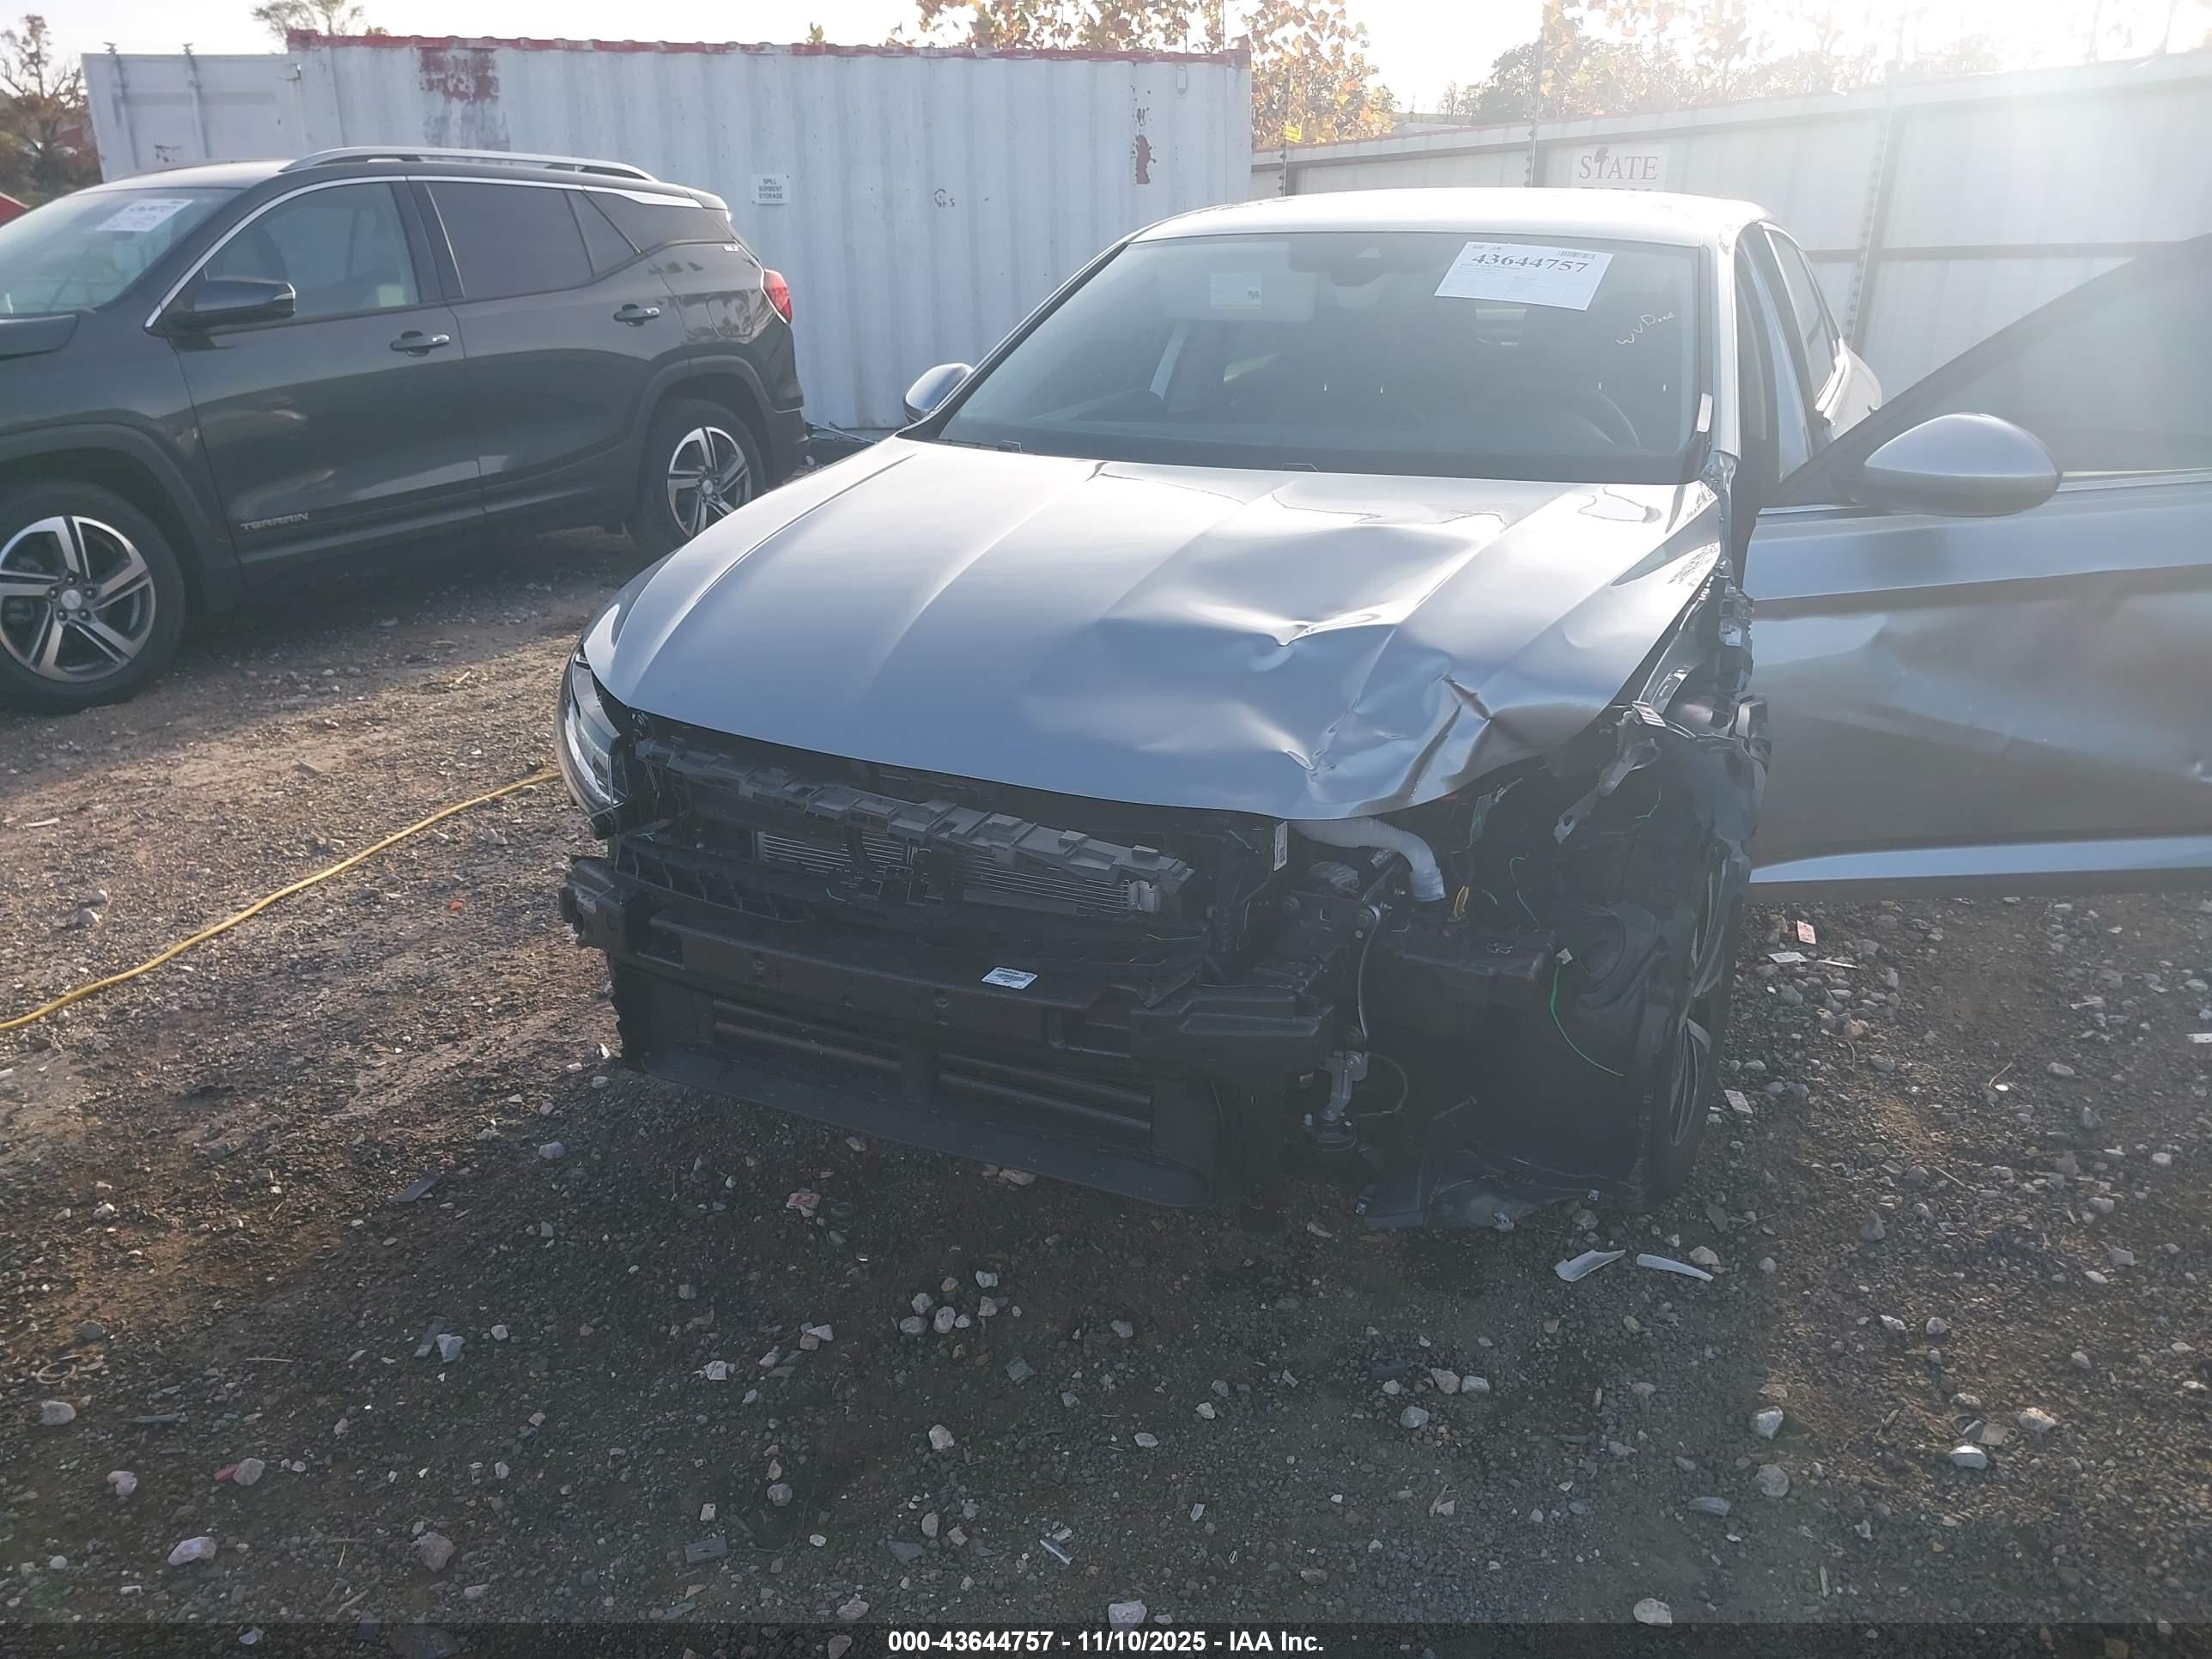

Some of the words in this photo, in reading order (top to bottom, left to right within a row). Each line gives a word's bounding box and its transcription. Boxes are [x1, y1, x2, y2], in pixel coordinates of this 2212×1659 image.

[1578, 152, 1659, 180] STATE
[1471, 252, 1590, 274] 43644757
[240, 511, 309, 531] TERRAIN
